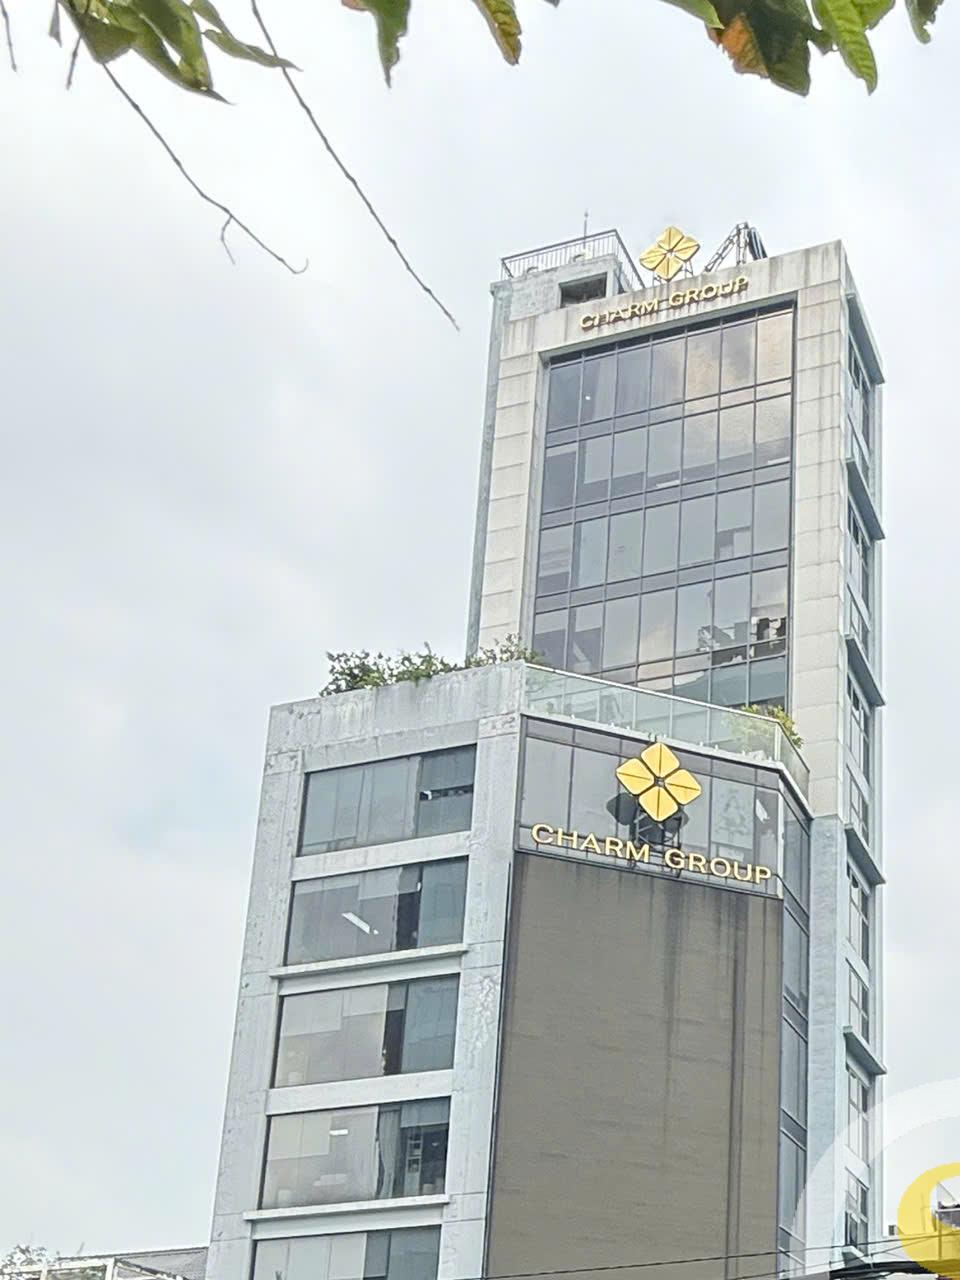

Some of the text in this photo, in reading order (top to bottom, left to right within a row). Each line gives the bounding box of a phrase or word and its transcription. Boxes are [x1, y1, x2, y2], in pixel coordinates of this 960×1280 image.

[579, 274, 750, 330] CHARM GROUP
[530, 823, 772, 885] CHARM GROUP
